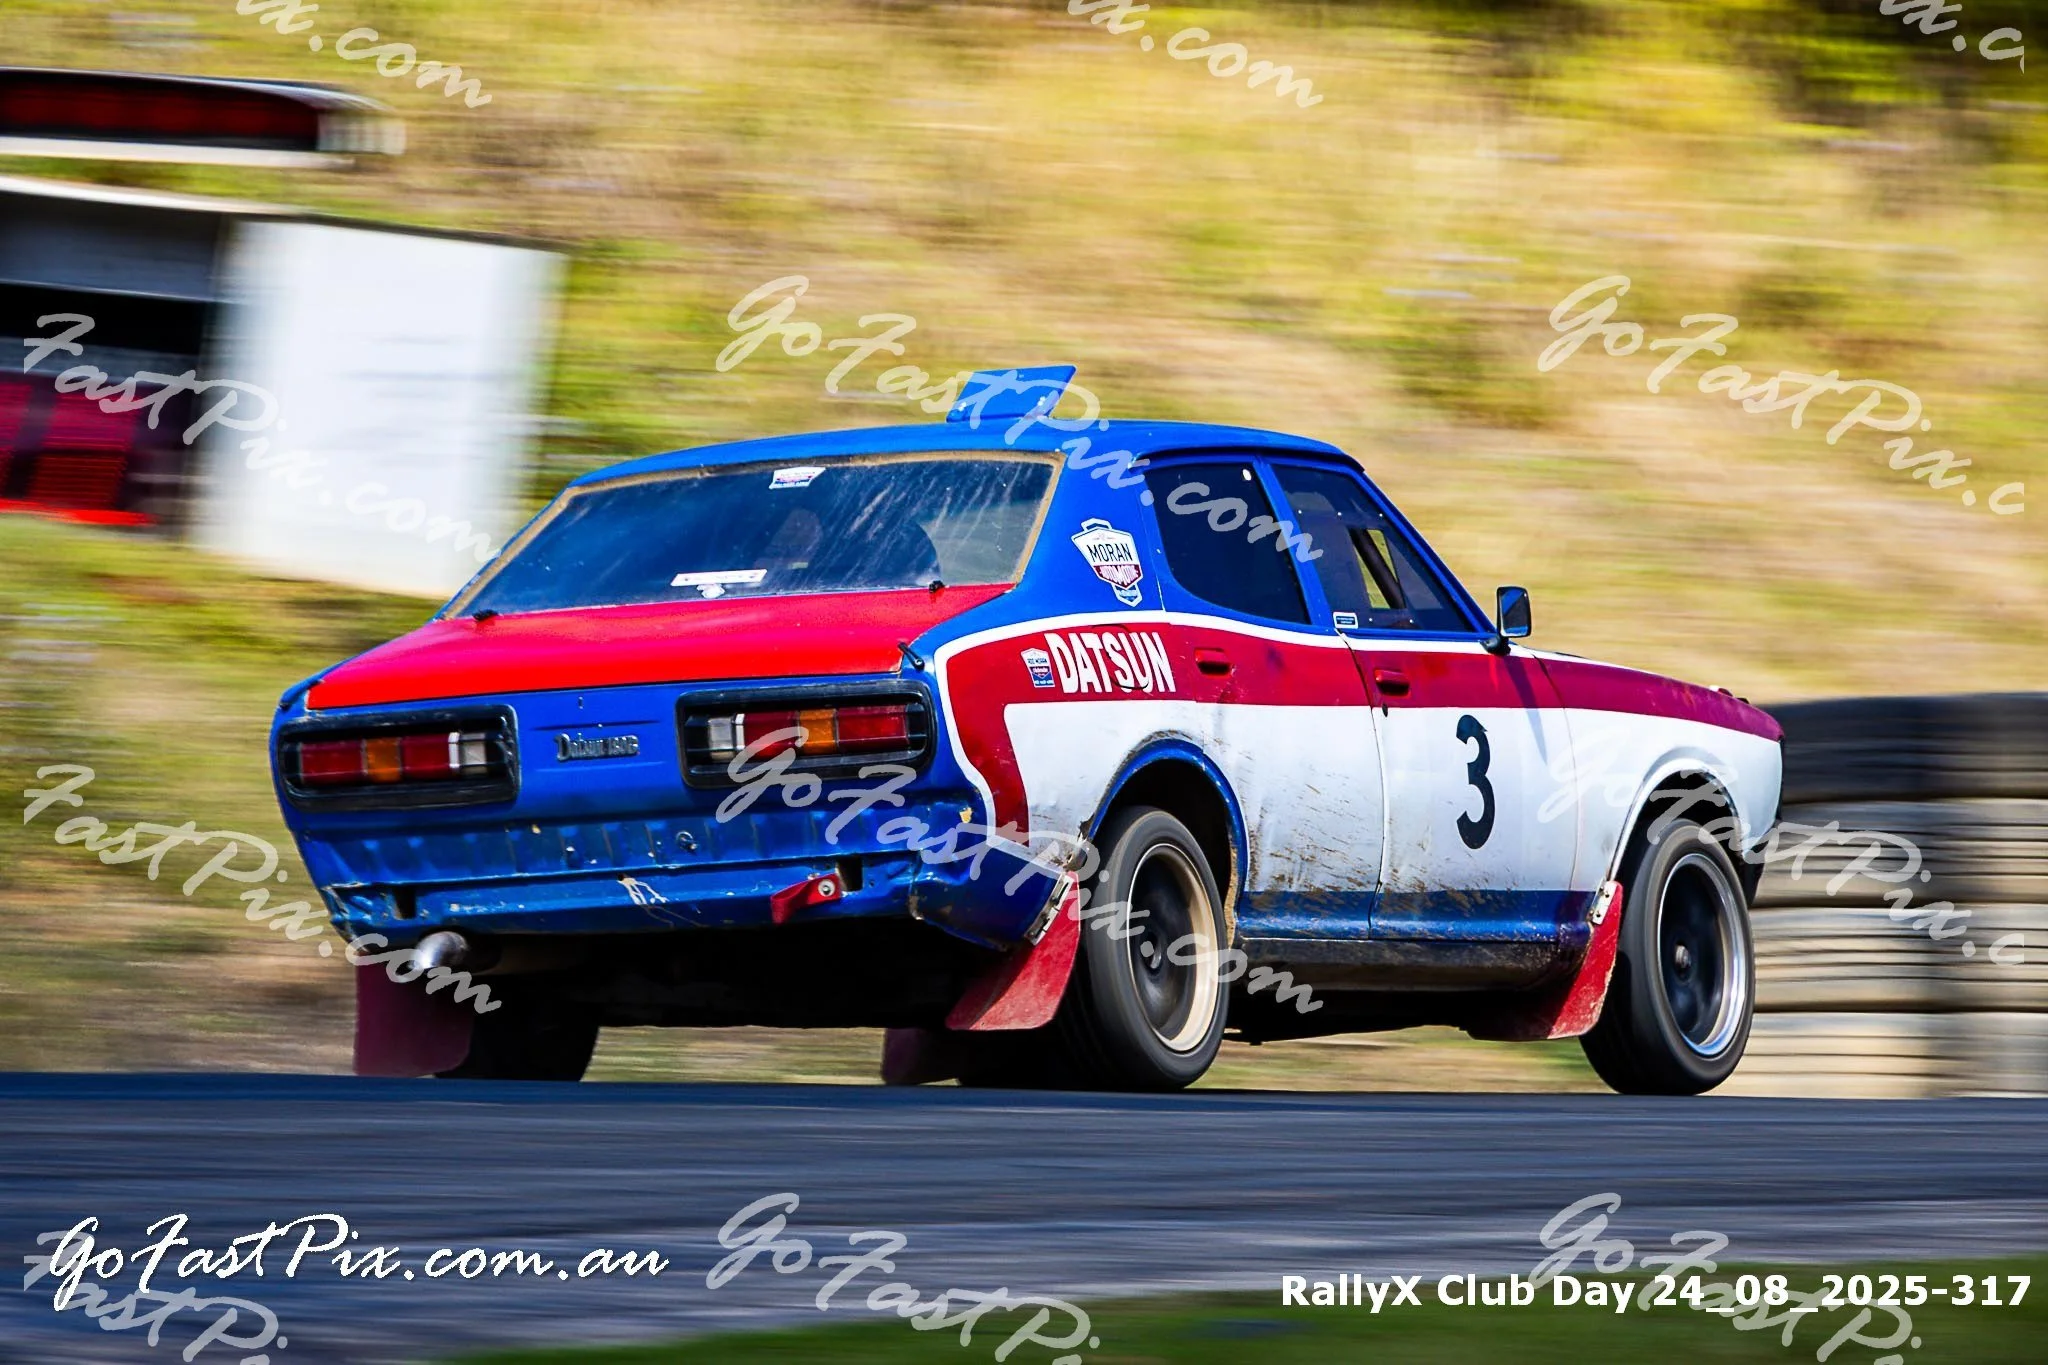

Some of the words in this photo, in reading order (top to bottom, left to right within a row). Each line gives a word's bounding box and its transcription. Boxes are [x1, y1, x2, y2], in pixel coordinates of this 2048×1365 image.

[1086, 543, 1133, 562] MORAN
[1044, 632, 1177, 693] DATSUN
[1456, 714, 1496, 850] 3
